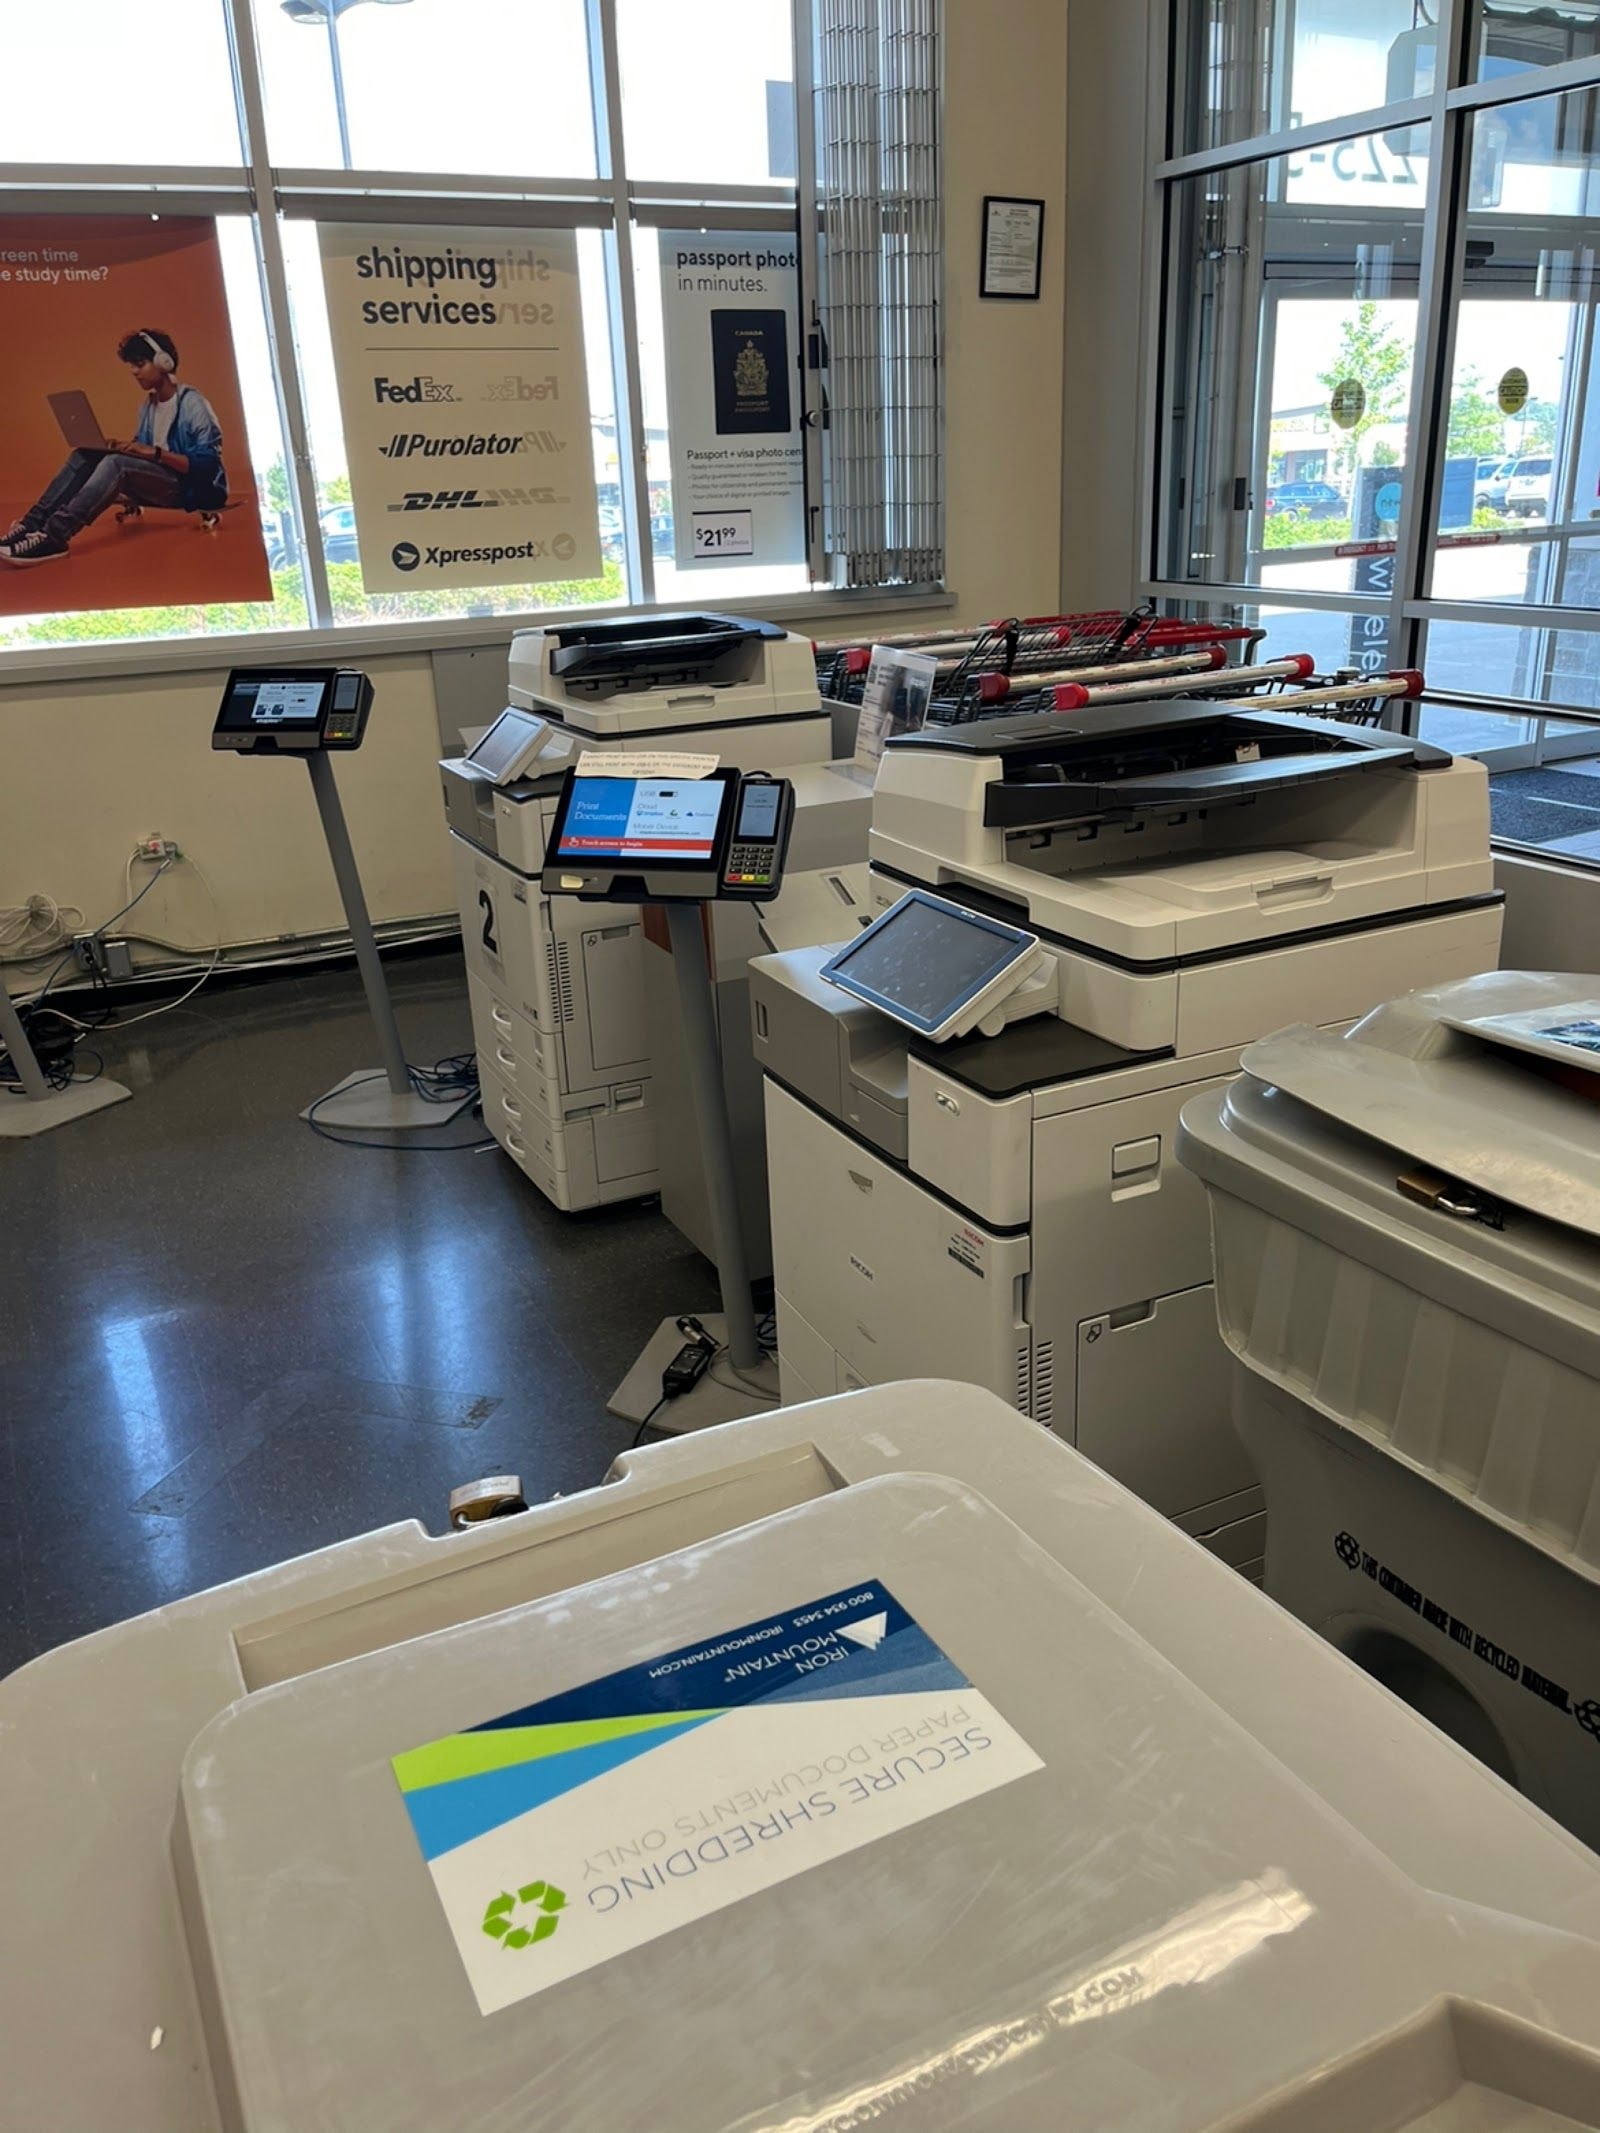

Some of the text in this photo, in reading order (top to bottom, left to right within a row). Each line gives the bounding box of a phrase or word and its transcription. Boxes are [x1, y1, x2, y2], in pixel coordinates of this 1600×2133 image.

[42, 248, 79, 262] time
[356, 246, 497, 289] shipping
[677, 251, 752, 270] passport
[15, 267, 60, 285] study
[64, 266, 109, 281] time?
[678, 273, 768, 292] in minutes.
[362, 293, 497, 325] services
[374, 376, 454, 403] FedEx
[407, 431, 524, 458] Purolator
[687, 449, 728, 461] Passport
[737, 449, 754, 458] visa
[756, 448, 783, 459] photo
[402, 490, 485, 512] DHL
[424, 541, 534, 568] Xpresspost
[574, 812, 627, 821] Documents
[577, 801, 600, 810] Print
[479, 889, 498, 955] 2
[649, 1591, 875, 1679] 800 934 3453 IRONMOUNTAIN.COM
[794, 1645, 849, 1674] IRON
[872, 1705, 972, 1755] PAPER
[840, 1726, 992, 1804] SECURE
[674, 1743, 873, 1837] DOCUMENTS
[580, 1829, 667, 1882] ONLY
[586, 1790, 838, 1914] SHREDDING
